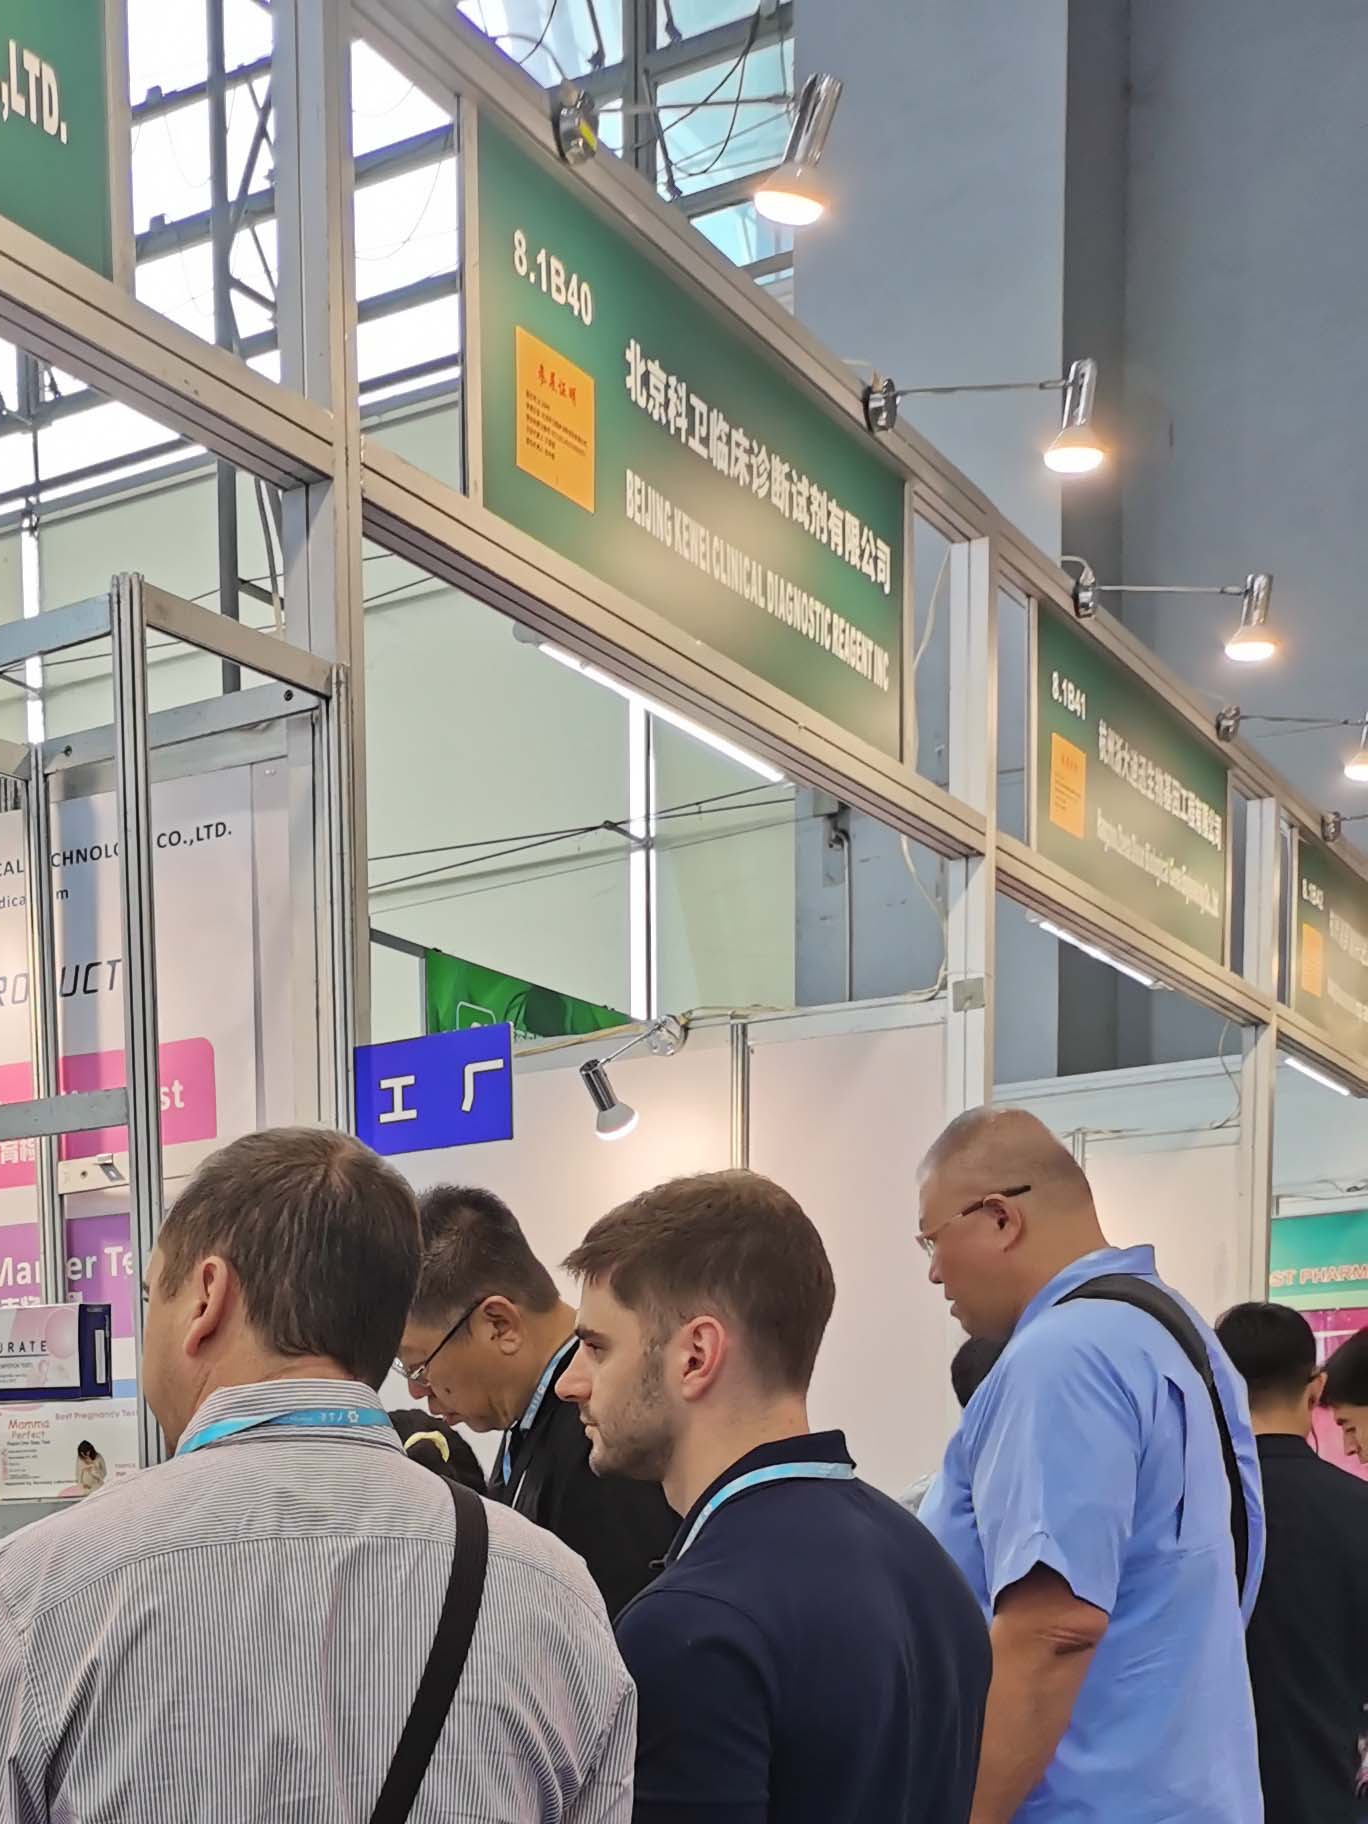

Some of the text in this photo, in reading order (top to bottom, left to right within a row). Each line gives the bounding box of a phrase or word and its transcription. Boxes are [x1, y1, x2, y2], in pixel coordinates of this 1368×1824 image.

[513, 229, 593, 326] 8.1B40
[625, 338, 890, 595] 北京科卫临床诊断试剂有限公司
[626, 468, 672, 547] BEIJING
[674, 506, 710, 575] KEWEI
[713, 536, 765, 608] CLINICAL
[767, 569, 832, 651] DIAGNOSTIC
[833, 613, 873, 680] REAGENT
[156, 821, 233, 850] CO.,LTD.
[8, 1419, 50, 1430] Mamma
[11, 1430, 46, 1440] Perfect
